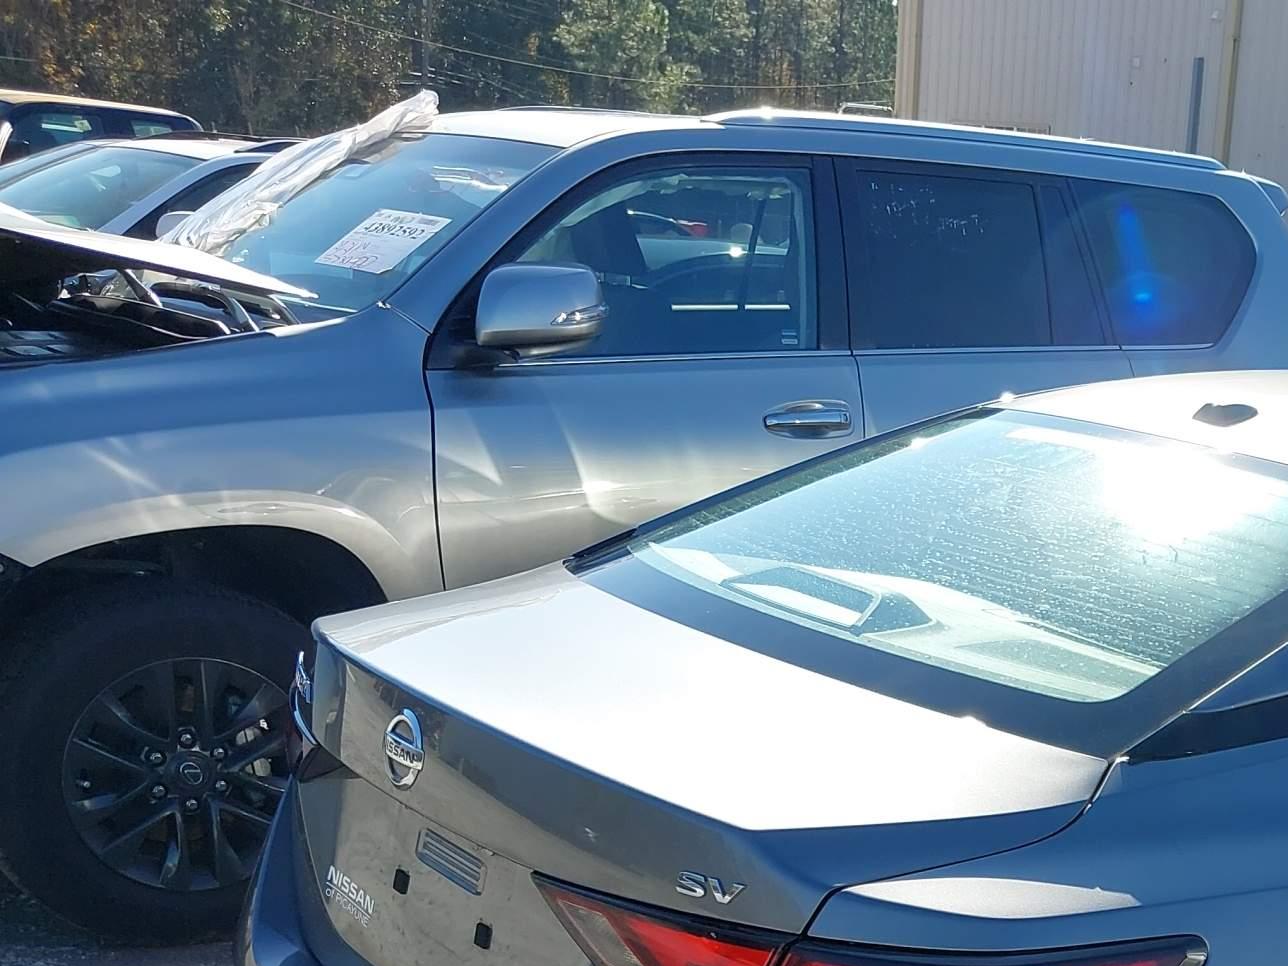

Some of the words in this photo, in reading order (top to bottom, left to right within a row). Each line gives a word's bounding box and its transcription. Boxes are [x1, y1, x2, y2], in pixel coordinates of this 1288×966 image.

[364, 222, 425, 240] 43892592
[327, 865, 375, 914] NISSAN
[674, 871, 745, 905] SV
[325, 888, 336, 898] of
[335, 892, 369, 928] PICAYUNE
